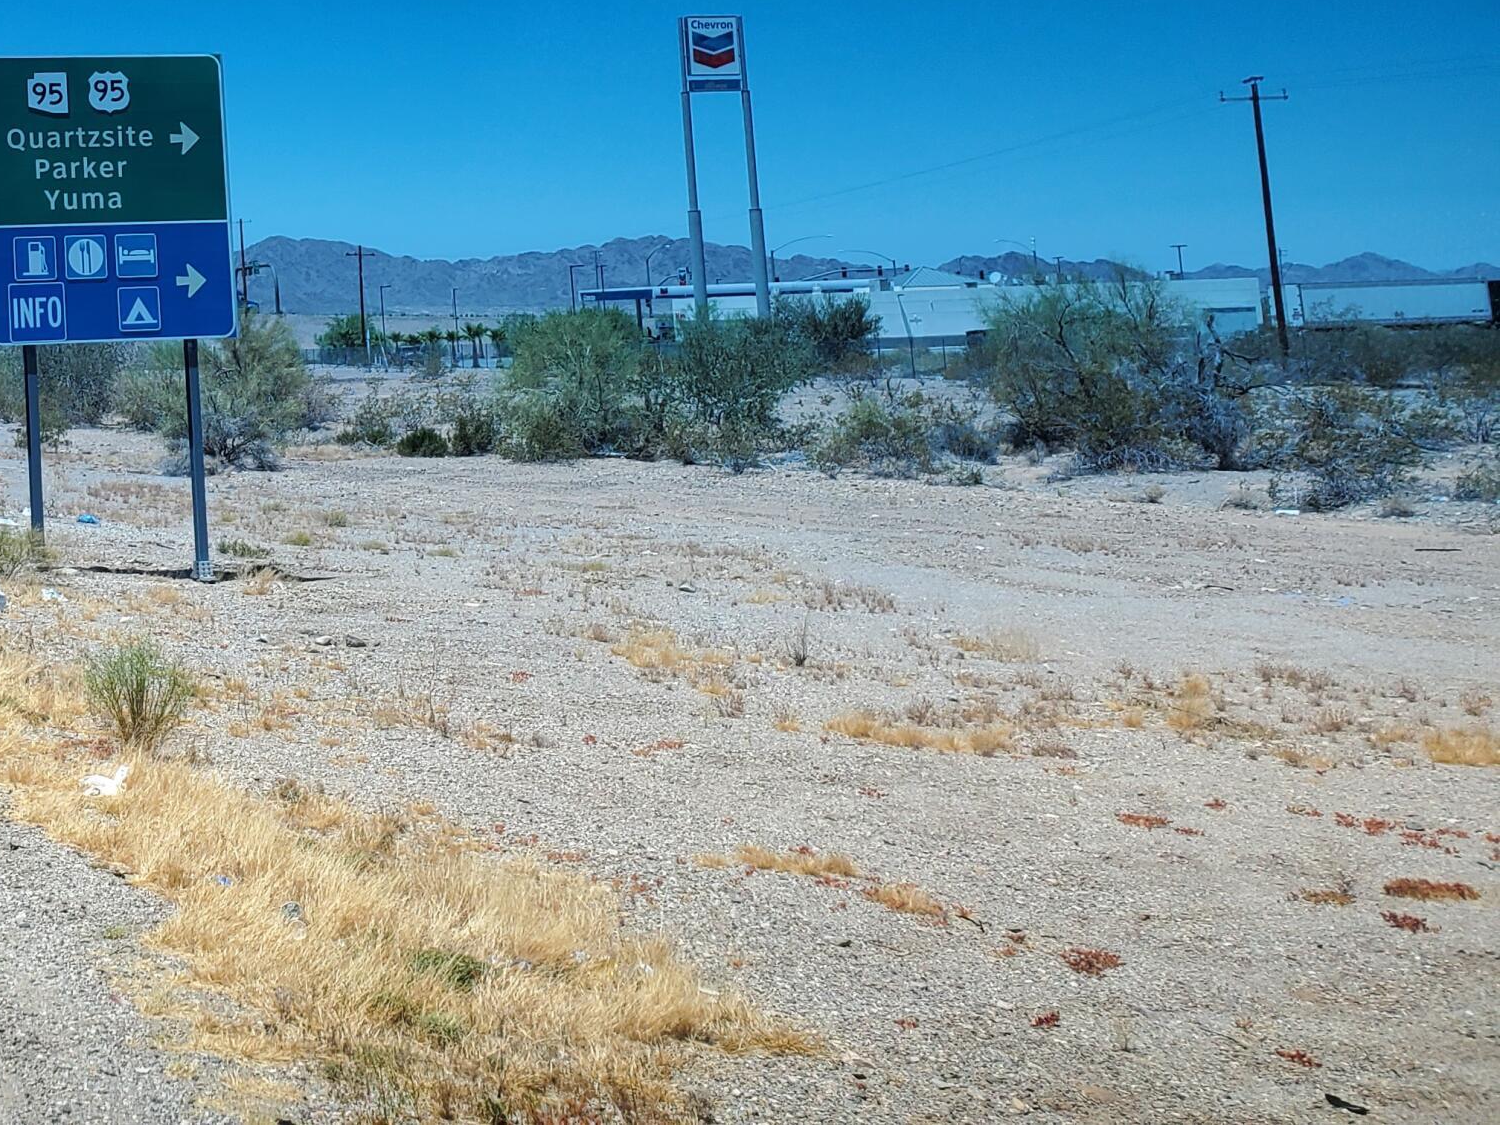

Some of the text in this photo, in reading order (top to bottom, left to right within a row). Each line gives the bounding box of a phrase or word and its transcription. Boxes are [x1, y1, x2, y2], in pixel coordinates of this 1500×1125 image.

[690, 19, 734, 30] Chevron
[32, 79, 125, 106] 95 95
[6, 125, 154, 152] Quartzsite
[35, 156, 128, 180] Parker
[43, 189, 123, 211] Yuma
[12, 295, 63, 330] INFO
